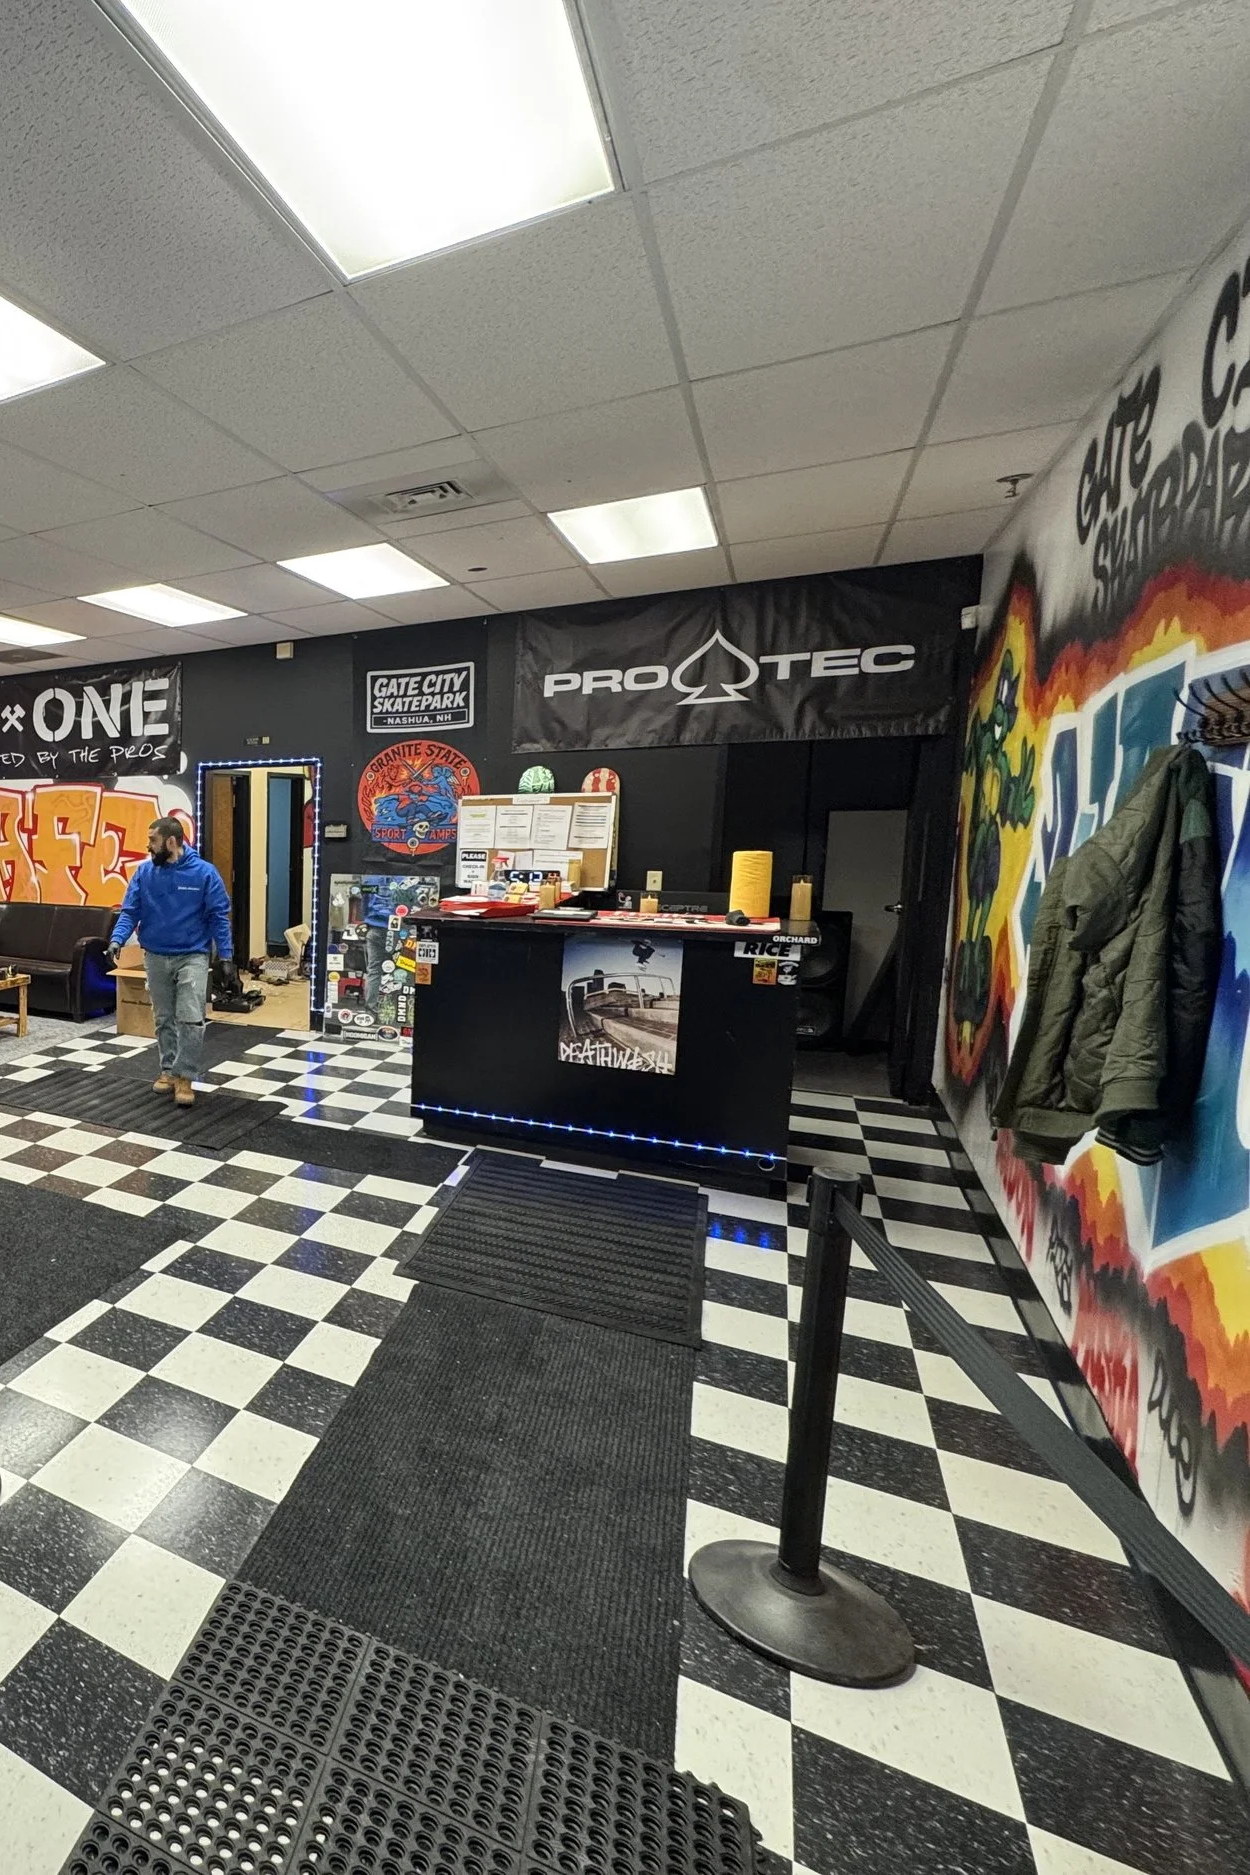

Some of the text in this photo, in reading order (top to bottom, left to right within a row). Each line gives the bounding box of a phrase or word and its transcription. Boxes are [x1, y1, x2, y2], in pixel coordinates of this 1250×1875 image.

[1076, 363, 1162, 546] GATE
[543, 644, 916, 698] PRO TEC
[373, 670, 468, 698] GATE CITY
[32, 678, 170, 743] ONE
[372, 691, 468, 714] SKATEPARK
[436, 713, 452, 722] NH
[37, 750, 60, 769] BY
[68, 746, 102, 763] THE
[108, 743, 169, 764] PROS
[370, 742, 467, 773] GRANITE STATE
[375, 828, 407, 839] SPORT
[658, 904, 708, 912] CEPTRE
[743, 942, 792, 957] RICE
[772, 935, 818, 944] ORCHARD
